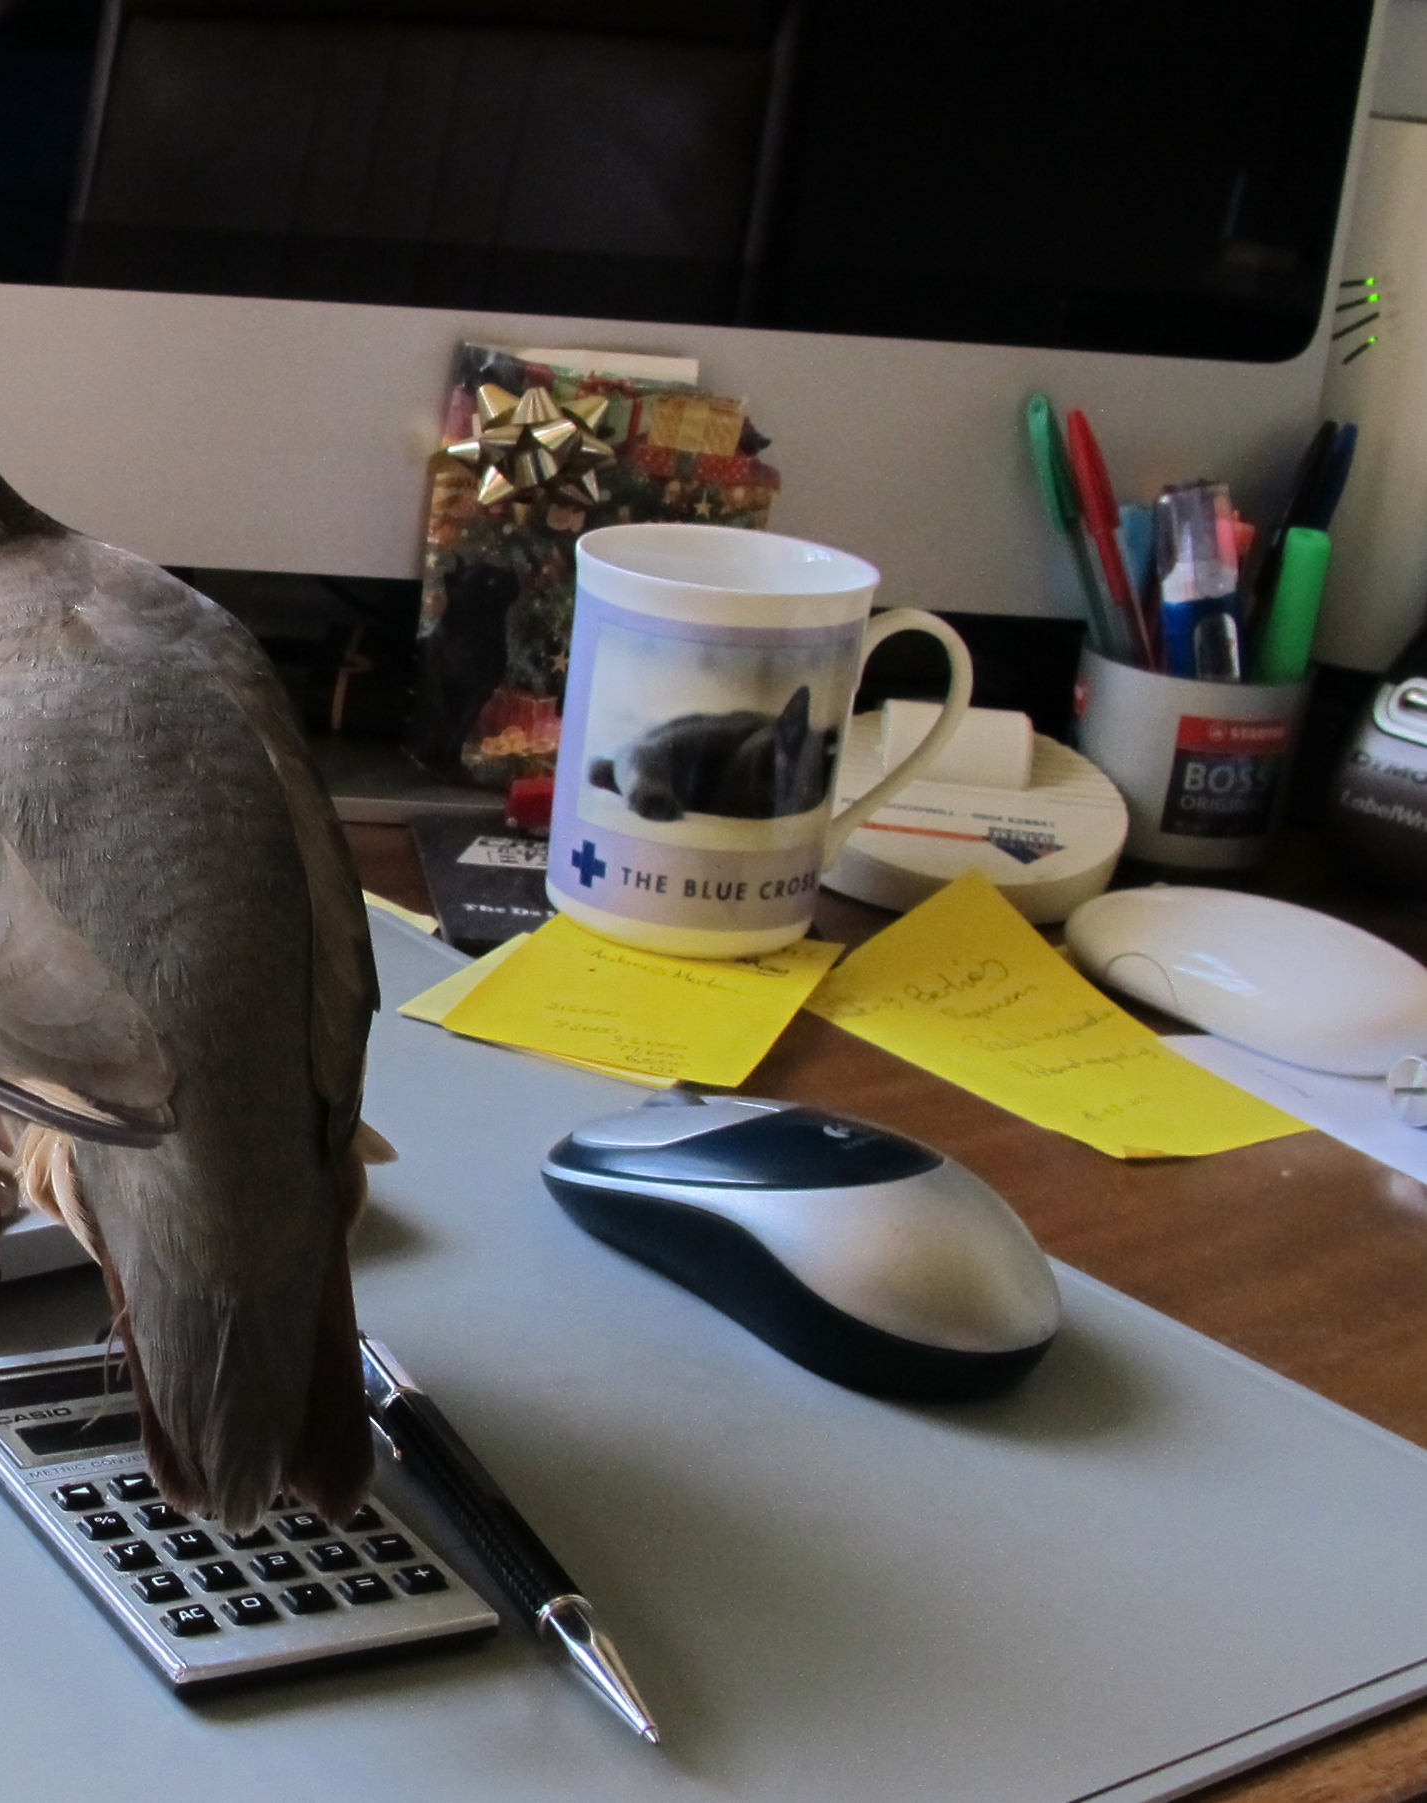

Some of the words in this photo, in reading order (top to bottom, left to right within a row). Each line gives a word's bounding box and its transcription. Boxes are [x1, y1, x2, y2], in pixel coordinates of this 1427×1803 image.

[621, 865, 669, 895] THE
[683, 878, 749, 901] BLUE
[759, 869, 818, 900] CROSS
[29, 1462, 88, 1480] METRIC
[151, 1504, 167, 1514] 7
[94, 1515, 117, 1526] %
[295, 1515, 314, 1526] 6
[179, 1534, 198, 1544] 4
[324, 1545, 344, 1557] 3
[270, 1554, 288, 1566] 2
[212, 1565, 225, 1576] 1
[150, 1576, 171, 1588] C
[241, 1596, 261, 1609] 0
[178, 1606, 206, 1622] AC
